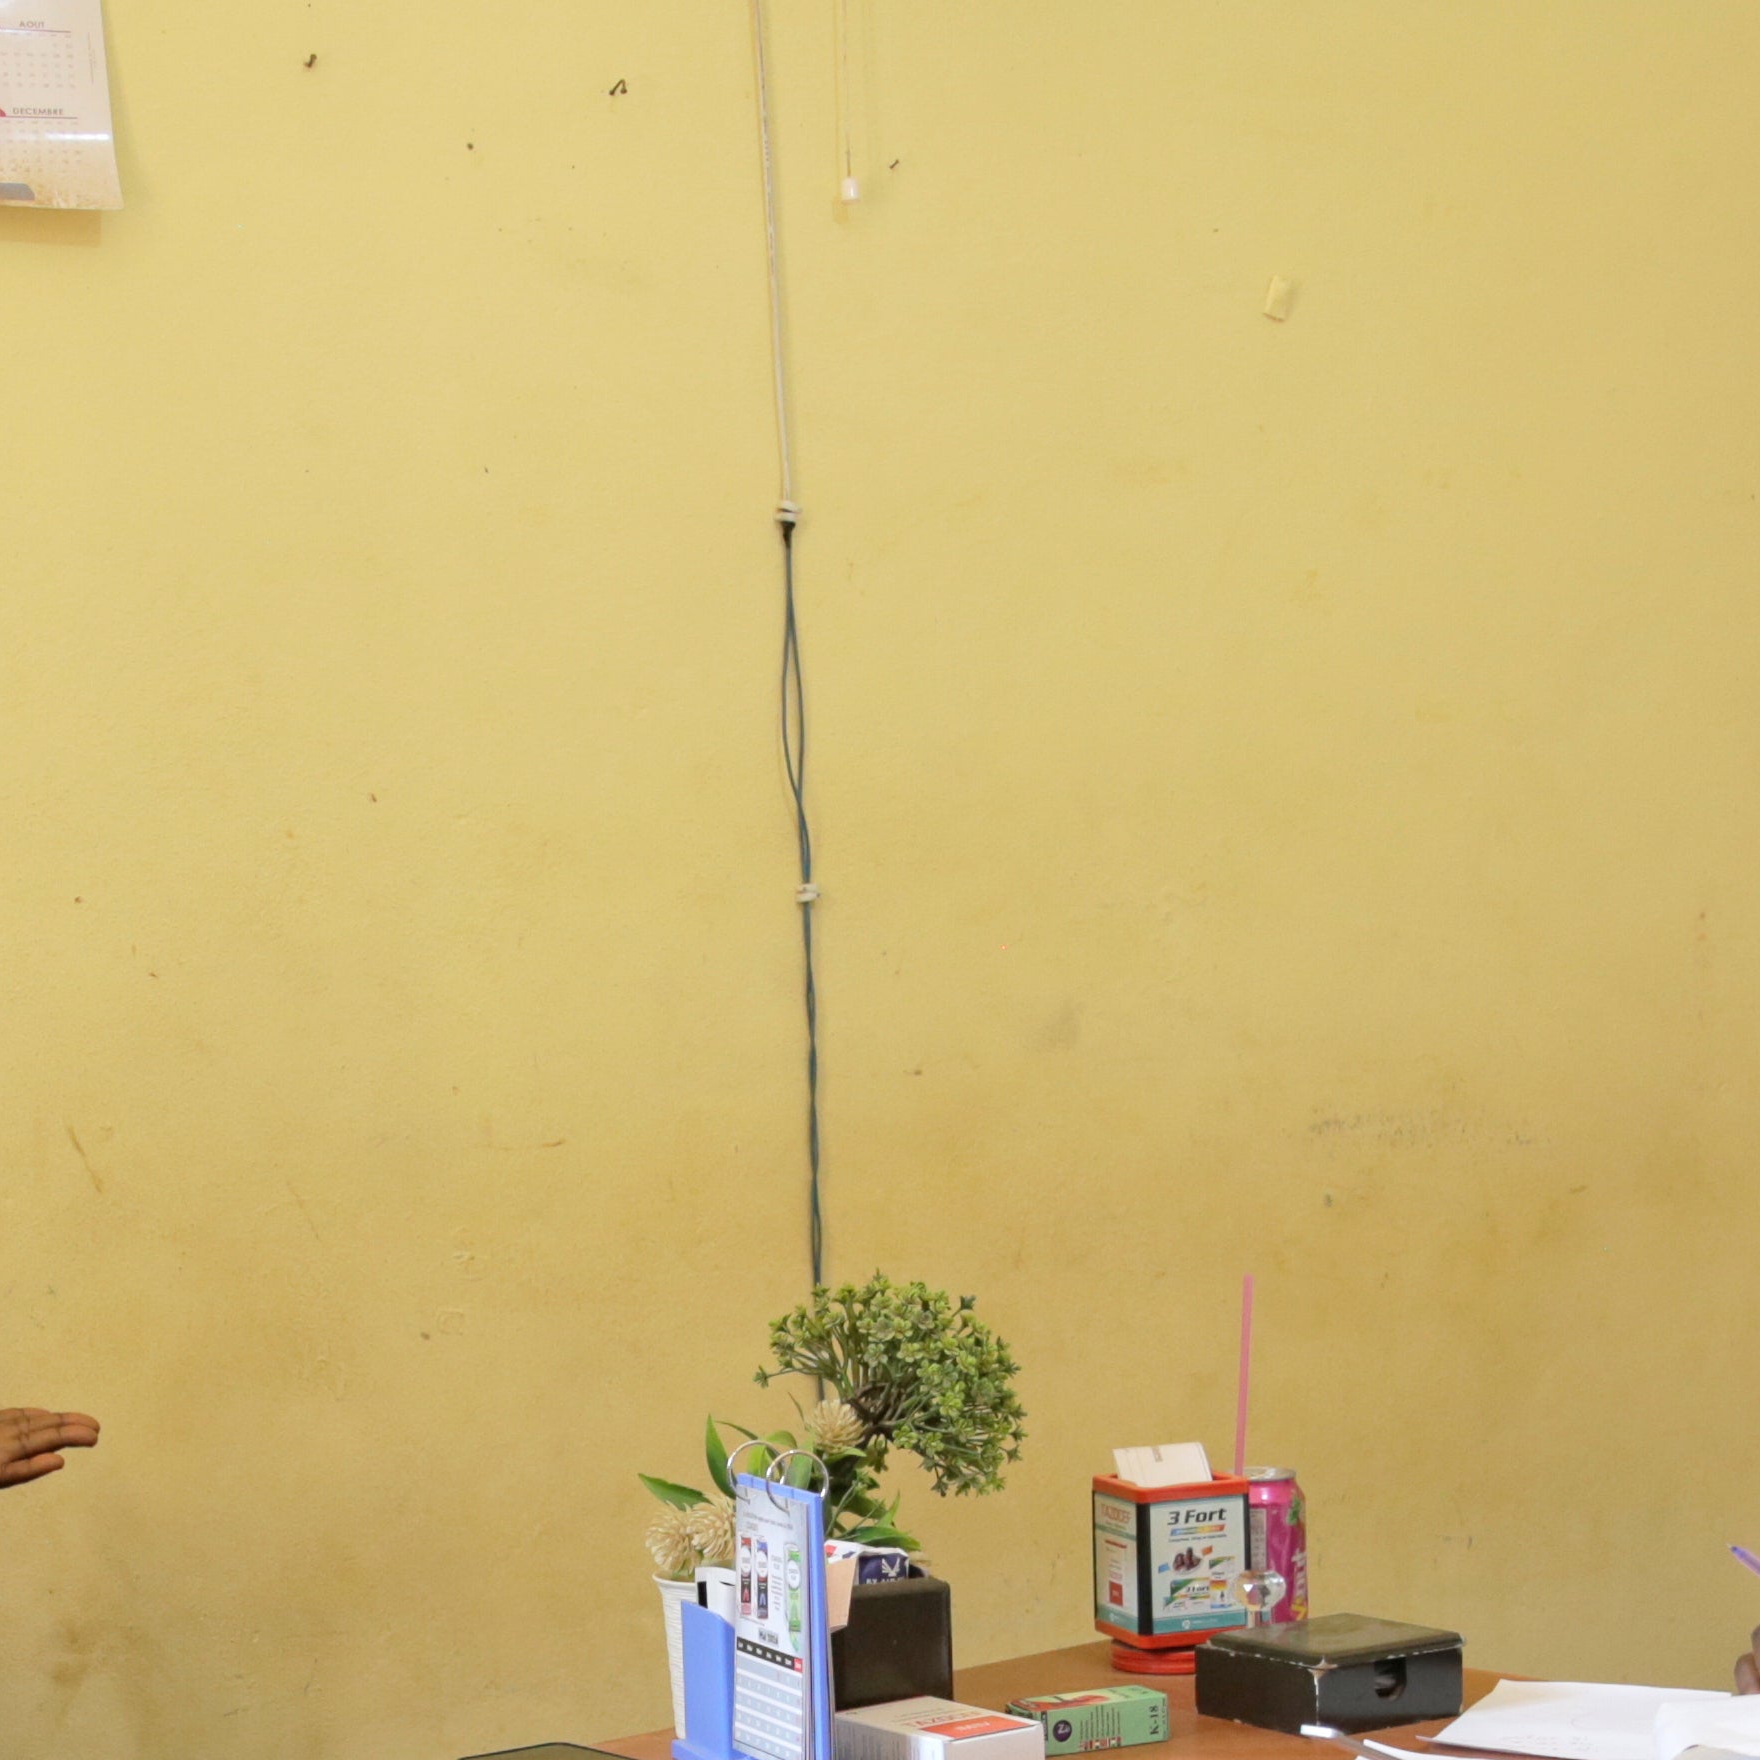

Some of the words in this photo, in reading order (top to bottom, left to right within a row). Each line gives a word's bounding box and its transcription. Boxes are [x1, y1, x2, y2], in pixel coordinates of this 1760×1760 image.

[1168, 1511, 1180, 1525] 3
[1184, 1508, 1227, 1524] Fort
[1149, 1705, 1159, 1735] K-18
